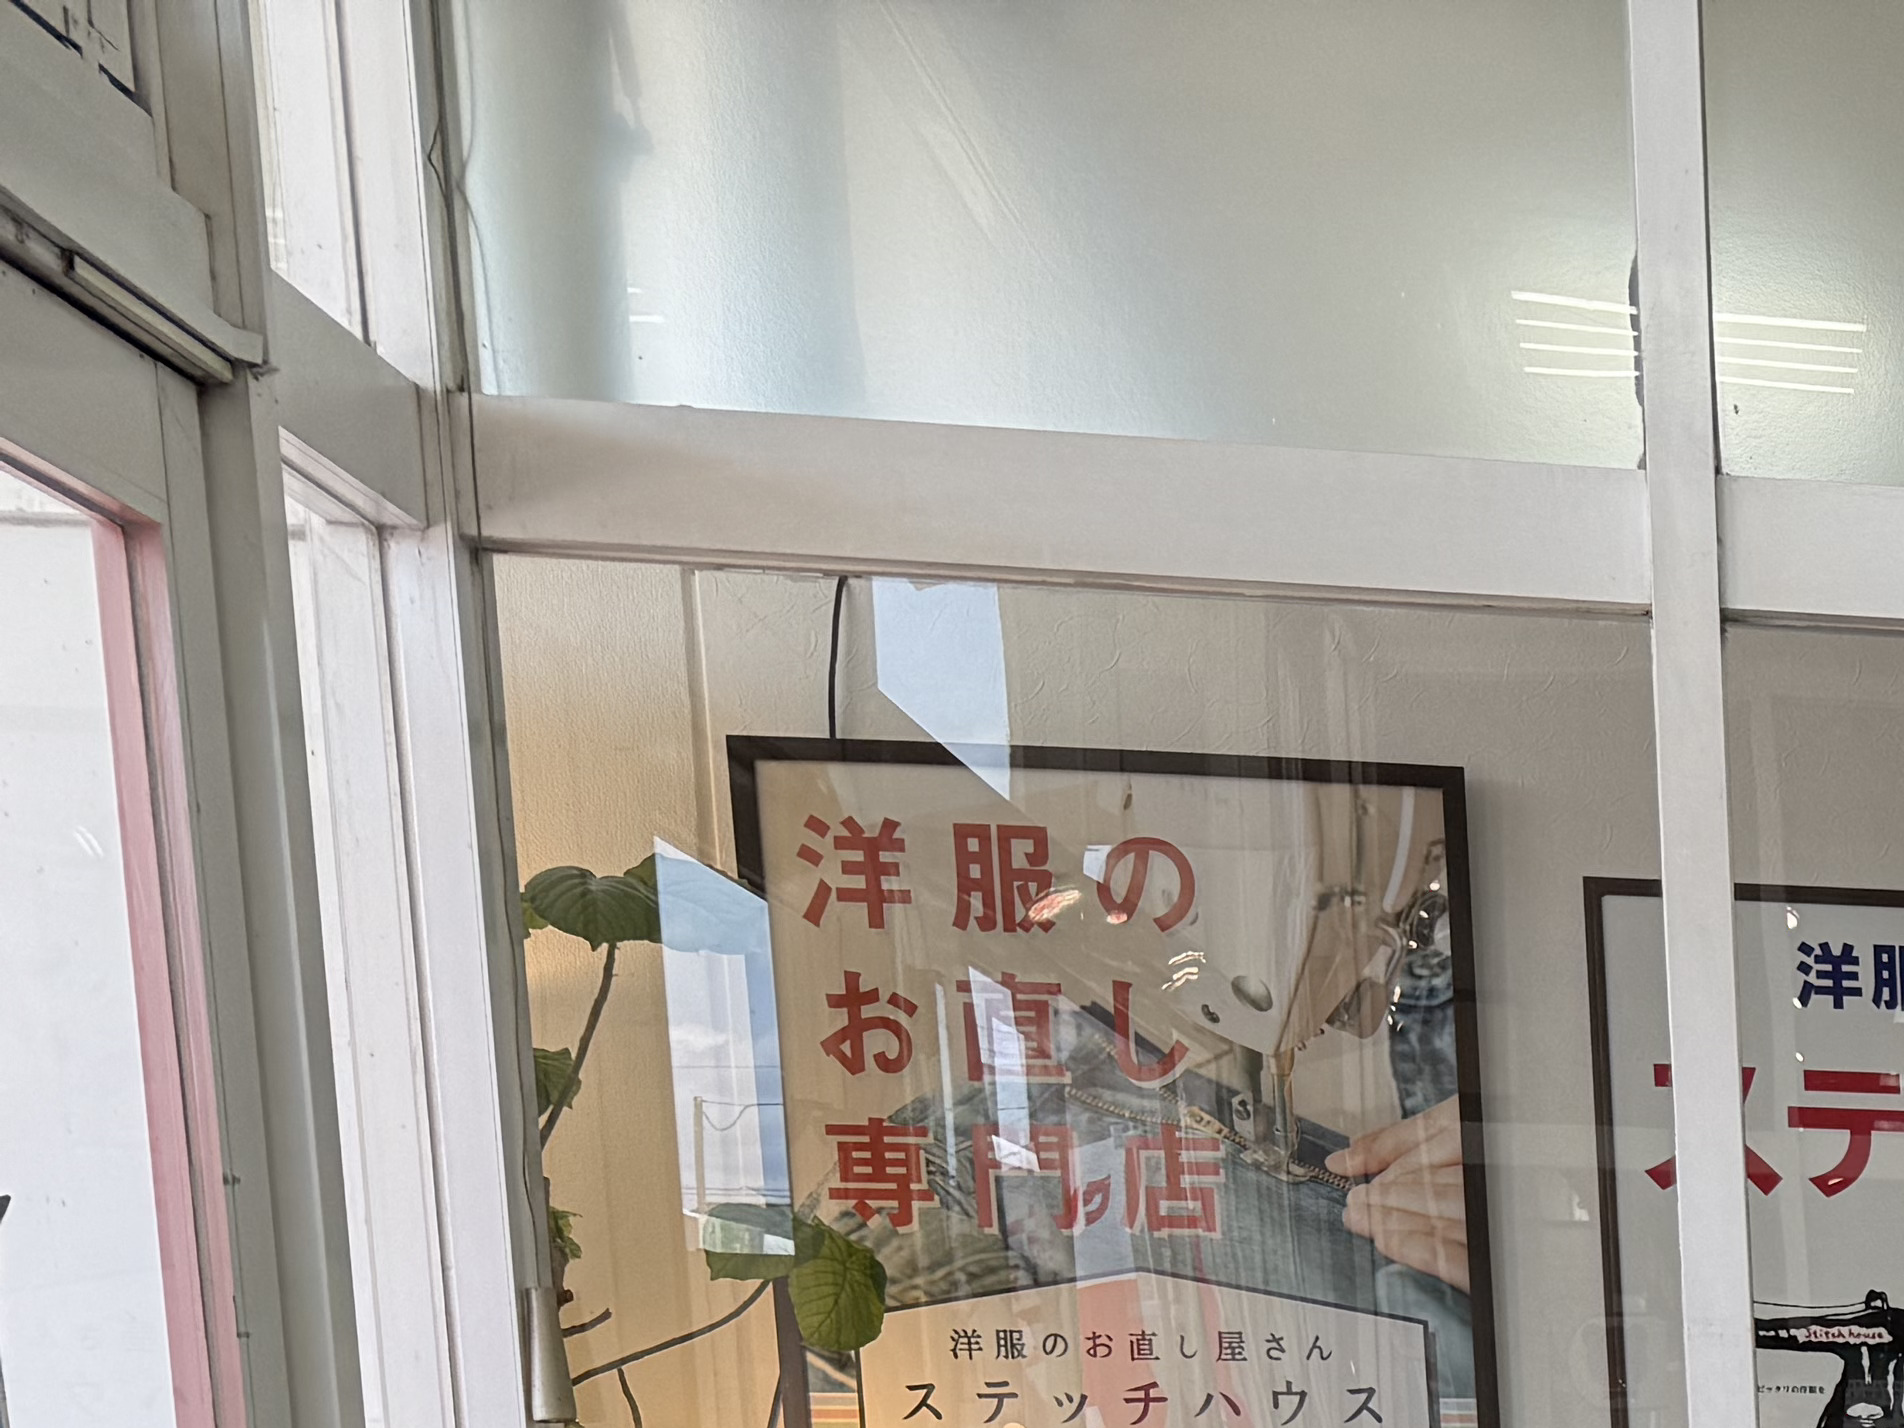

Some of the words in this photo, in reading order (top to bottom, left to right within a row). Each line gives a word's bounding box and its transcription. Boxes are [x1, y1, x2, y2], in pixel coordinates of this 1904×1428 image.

[797, 812, 1199, 936] 洋服の
[819, 968, 1192, 1084] お直し
[824, 1118, 1226, 1236] 専門店
[902, 1378, 1386, 1428] ステッチハウス
[949, 1326, 1336, 1367] 洋服のお直し屋さん
